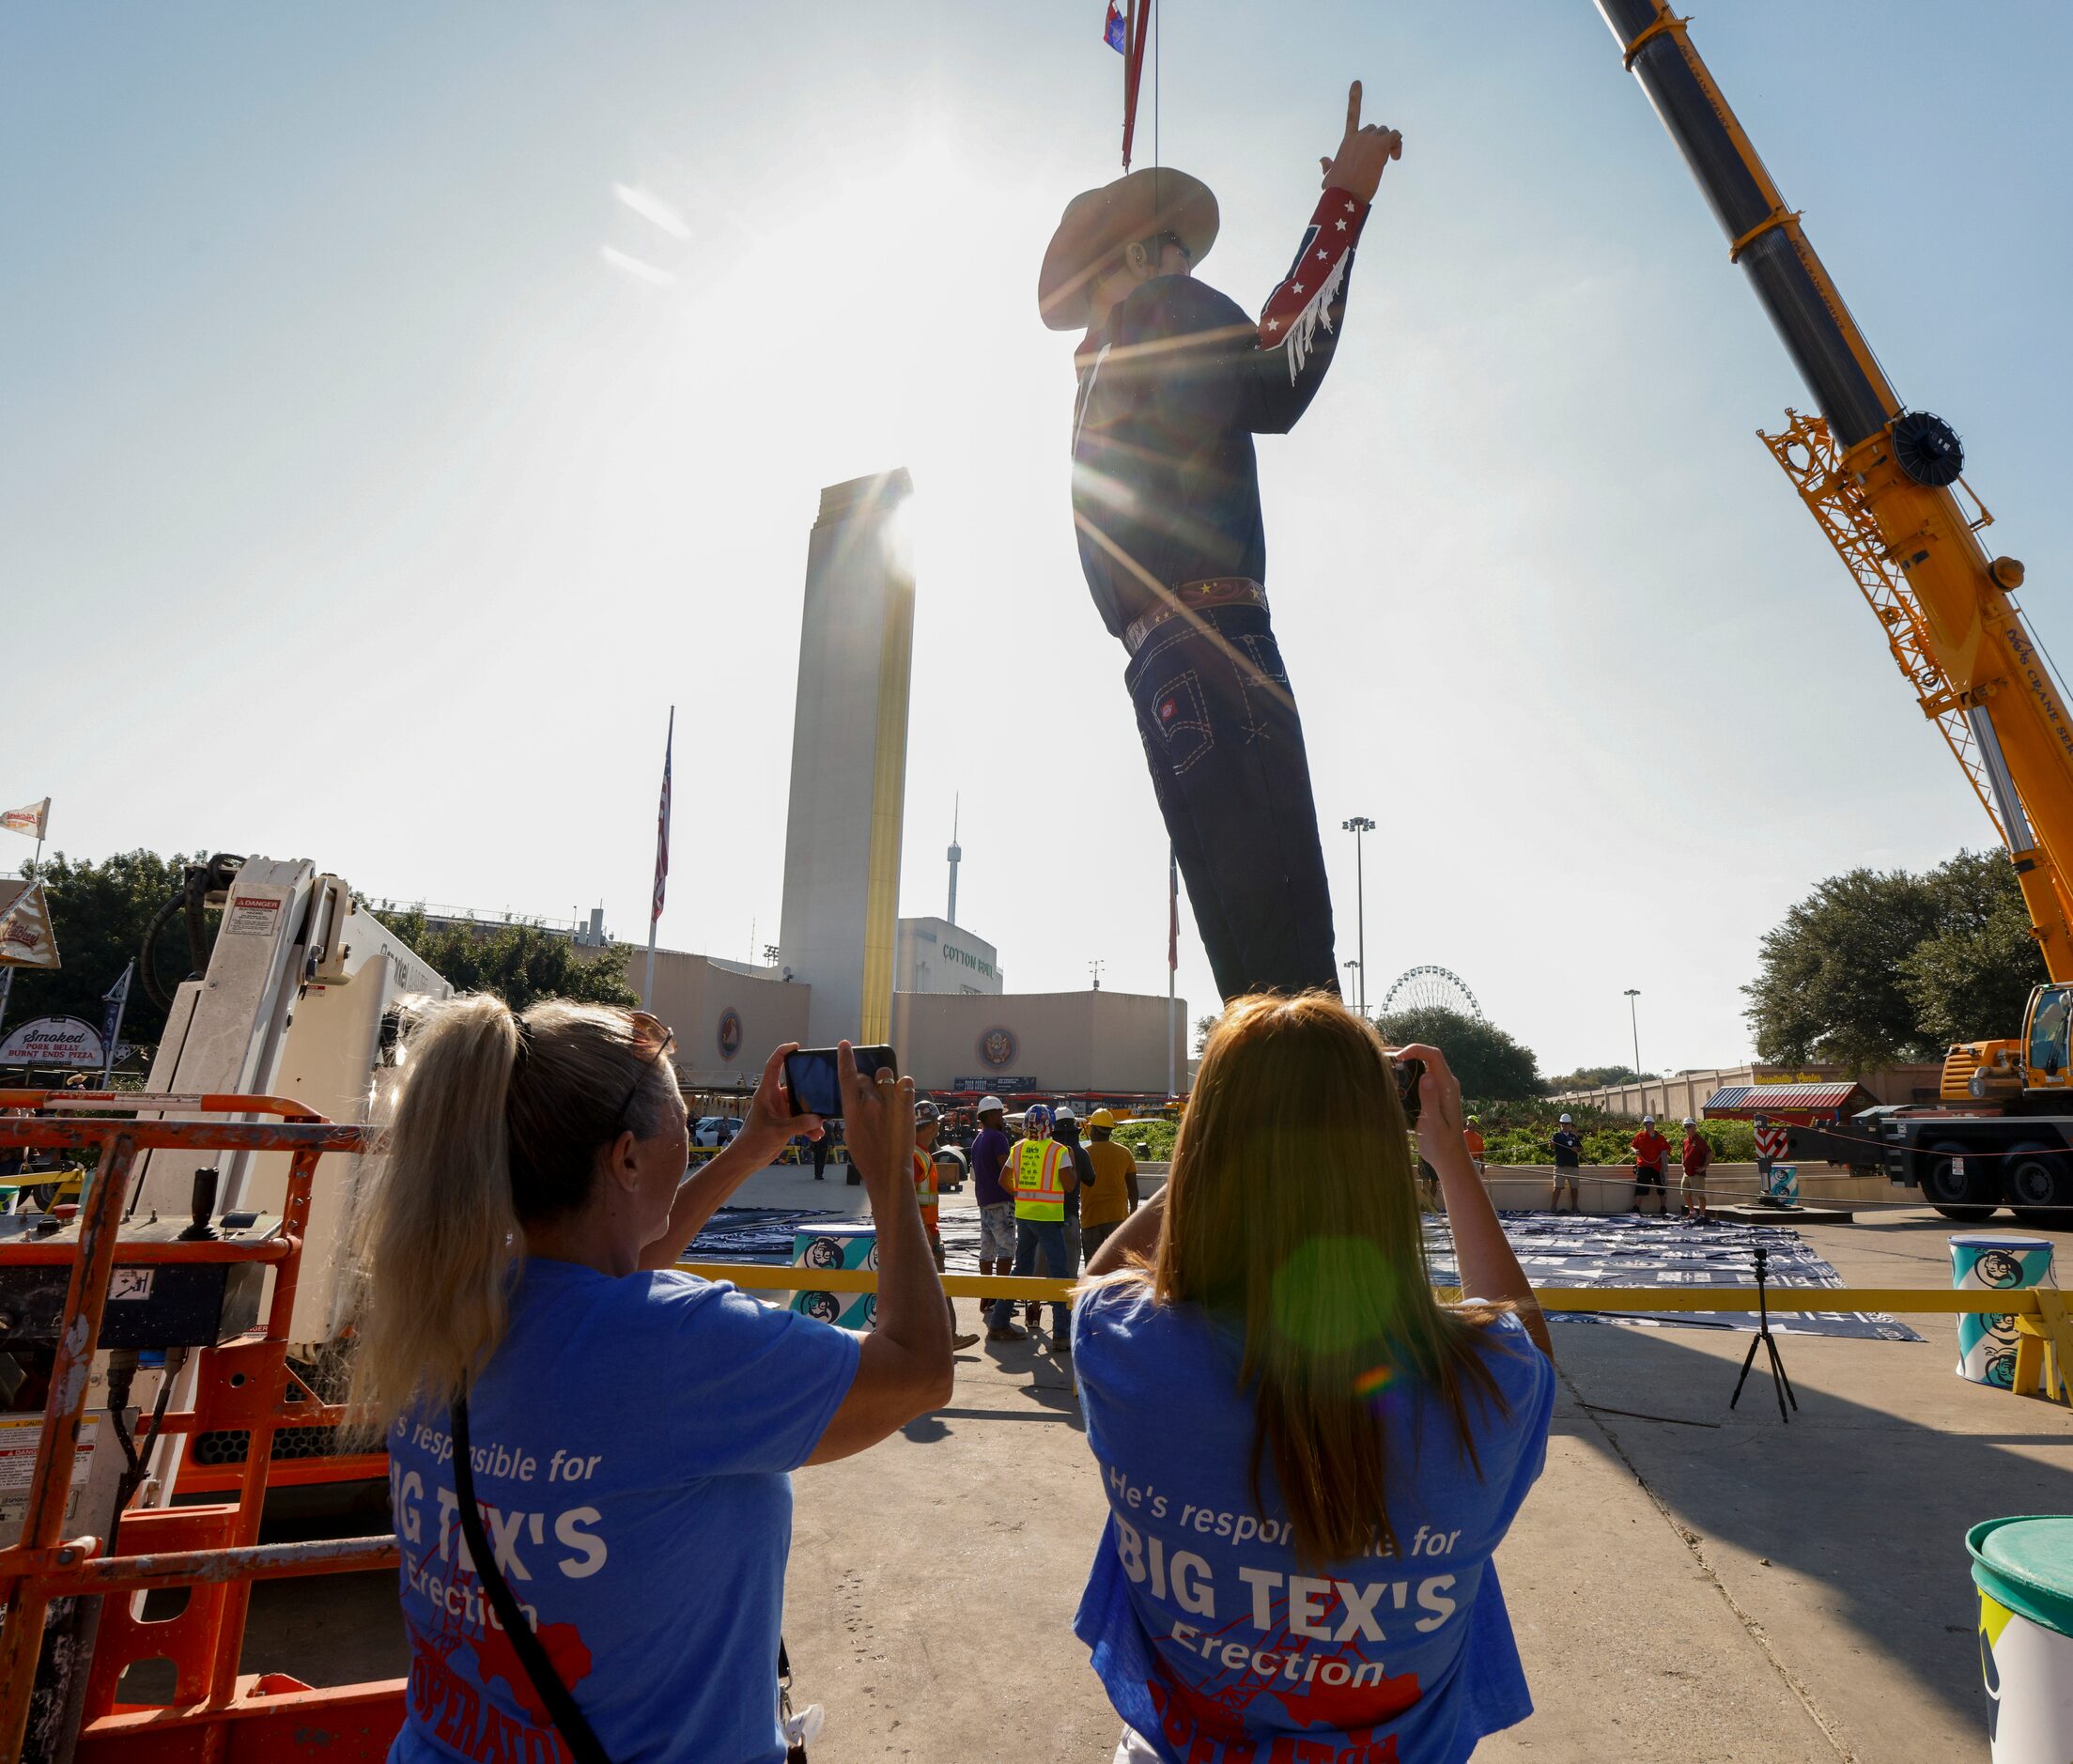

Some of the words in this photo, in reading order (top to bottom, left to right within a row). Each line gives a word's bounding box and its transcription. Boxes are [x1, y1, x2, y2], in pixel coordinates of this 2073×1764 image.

[2027, 669, 2059, 722] CRANE
[943, 944, 976, 969] COTTON
[23, 1029, 85, 1044] Smoked
[1755, 1074, 1792, 1085] Hospitality
[1796, 1072, 1822, 1084] Center
[411, 1423, 536, 1482] respnsible
[548, 1449, 602, 1482] for
[390, 1460, 424, 1545] IG
[1109, 1465, 1168, 1519] He's
[1180, 1504, 1394, 1558] respole
[1411, 1524, 1462, 1556] for
[1114, 1509, 1215, 1619] BIG
[1238, 1566, 1456, 1642] TEX'S
[1171, 1620, 1385, 1689] Erection
[412, 1656, 576, 1764] OPERATO
